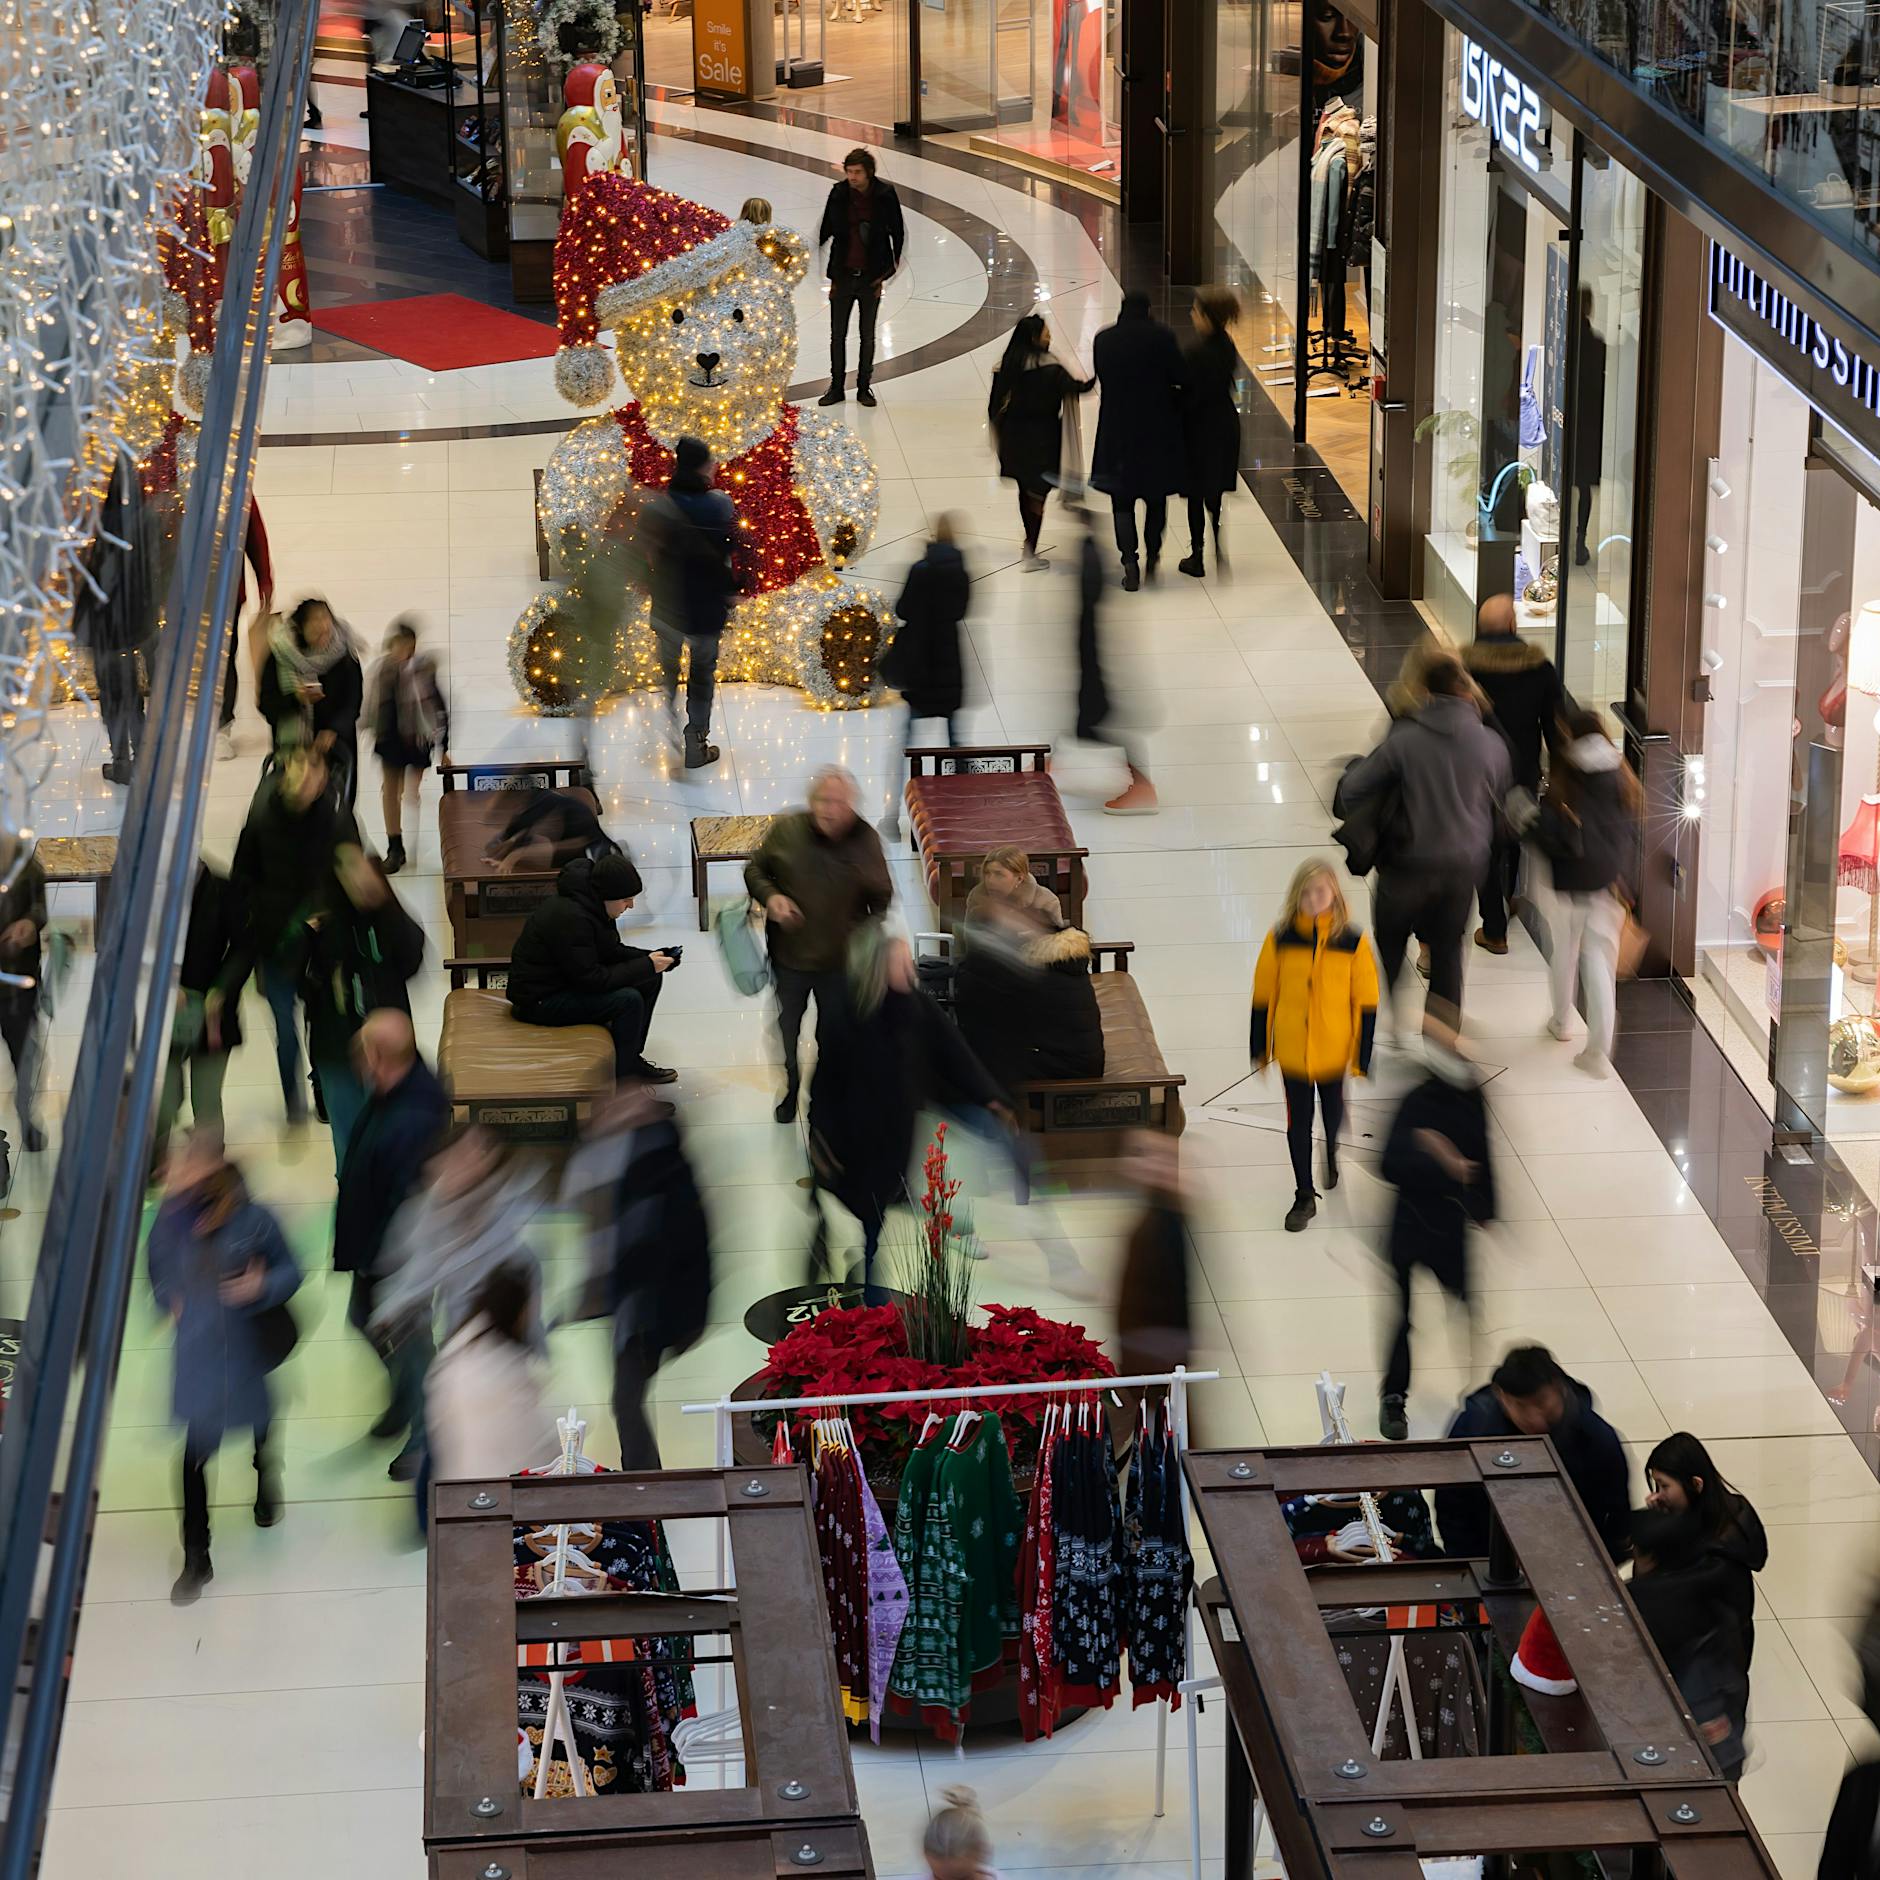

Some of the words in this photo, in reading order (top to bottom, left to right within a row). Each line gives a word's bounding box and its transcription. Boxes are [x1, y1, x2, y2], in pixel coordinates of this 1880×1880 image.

[706, 20, 732, 36] Smile
[713, 40, 727, 53] it's
[699, 53, 742, 85] Sale
[1743, 1176, 1821, 1256] INTIMISSIMI
